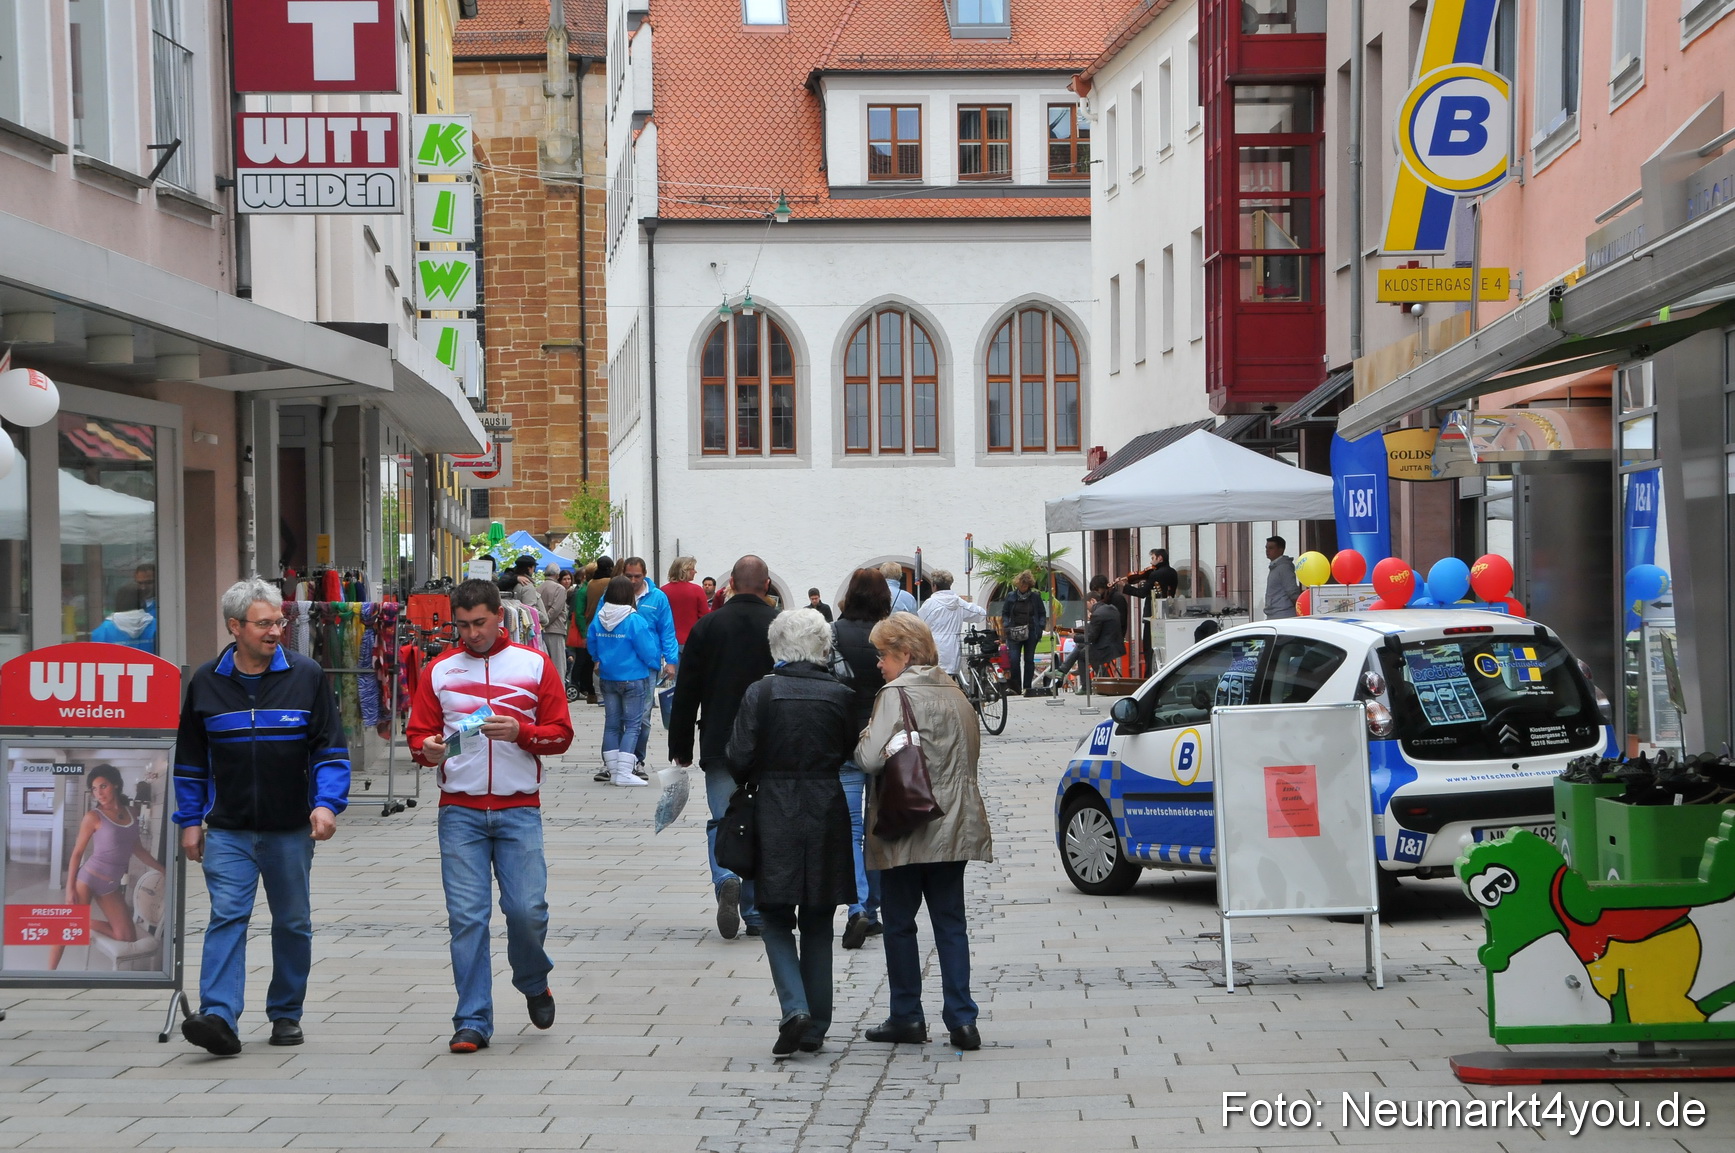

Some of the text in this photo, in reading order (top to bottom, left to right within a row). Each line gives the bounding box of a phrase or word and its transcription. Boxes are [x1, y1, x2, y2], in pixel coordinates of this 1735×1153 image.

[1428, 96, 1490, 156] B
[243, 117, 392, 164] WITT
[1385, 278, 1502, 292] KLOSTERGASE 4
[1390, 450, 1434, 460] GOLDS
[30, 662, 154, 702] WITT
[59, 705, 125, 718] weiden
[1529, 725, 1561, 733] Klostergasse
[1094, 727, 1111, 745] 1&1
[1530, 732, 1561, 740] Glasergasse
[1178, 742, 1195, 771] B
[23, 765, 83, 773] POMPADOUR
[1126, 806, 1214, 817] www.bretschneider-neu
[1399, 836, 1424, 856] 1&1
[32, 908, 72, 916] PREISTIPP
